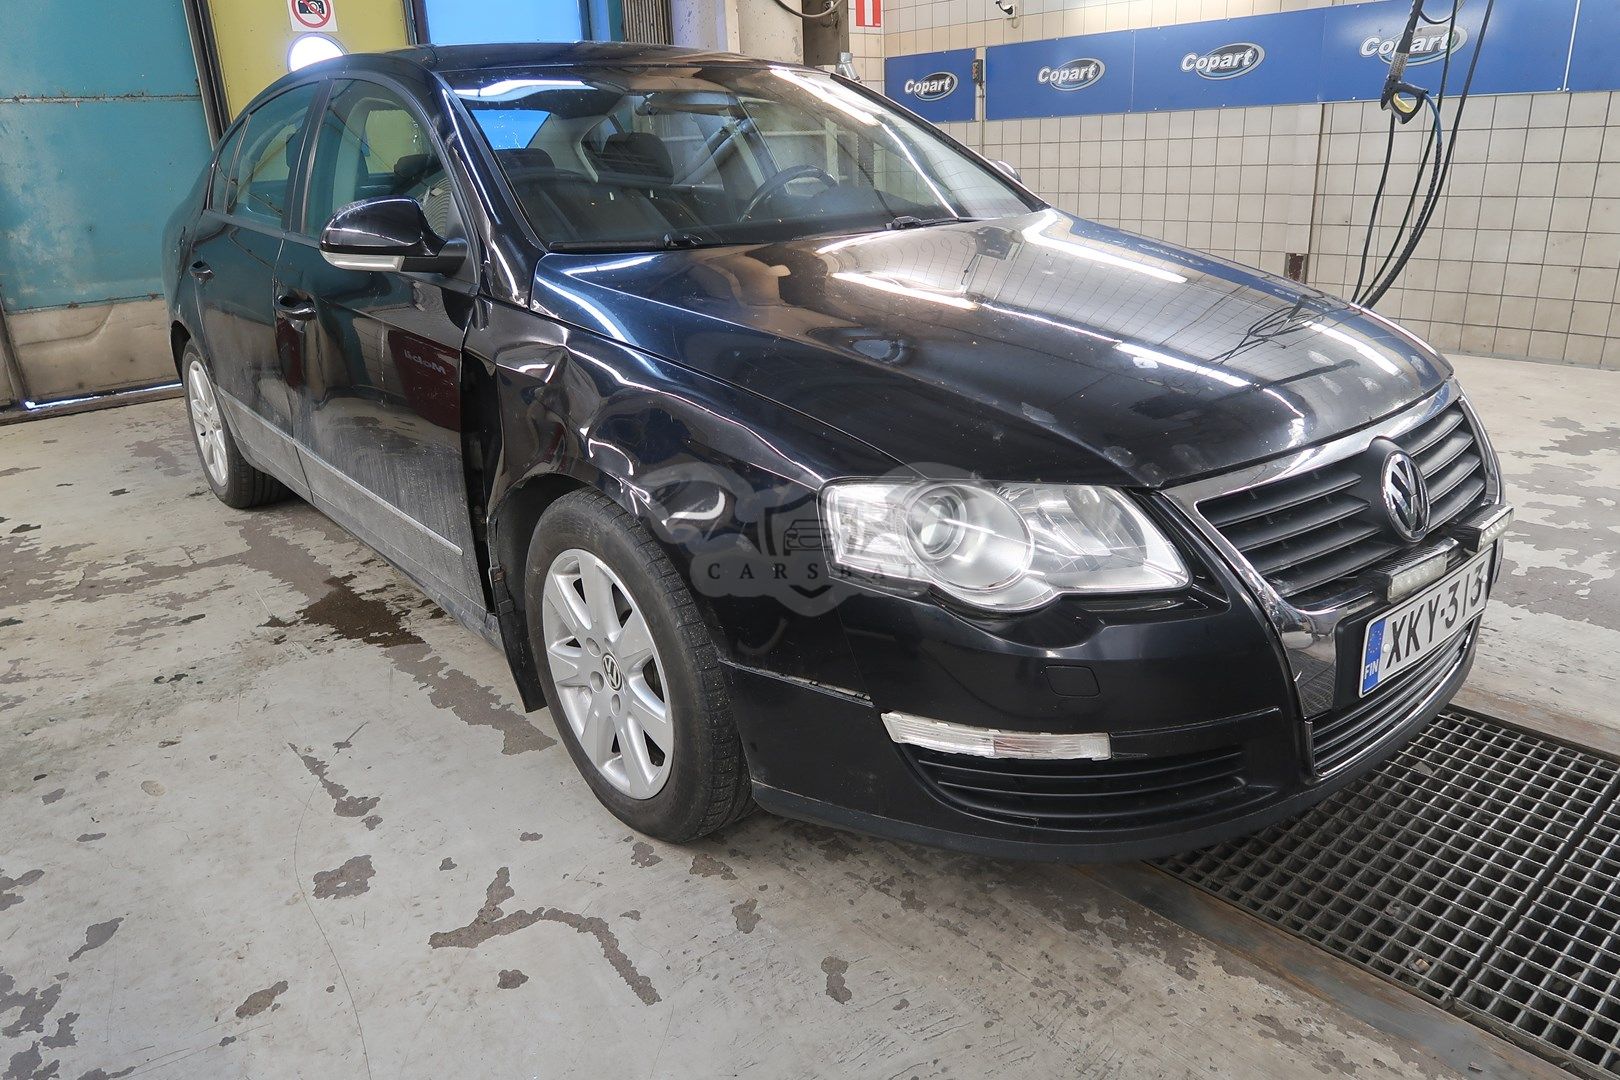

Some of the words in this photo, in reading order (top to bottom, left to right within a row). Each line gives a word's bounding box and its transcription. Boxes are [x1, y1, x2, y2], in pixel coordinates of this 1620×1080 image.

[1181, 49, 1254, 73] Copart
[1038, 63, 1096, 84] Copart
[904, 77, 952, 95] Copart
[1386, 561, 1485, 669] XKY-313
[1364, 659, 1379, 681] FIN
